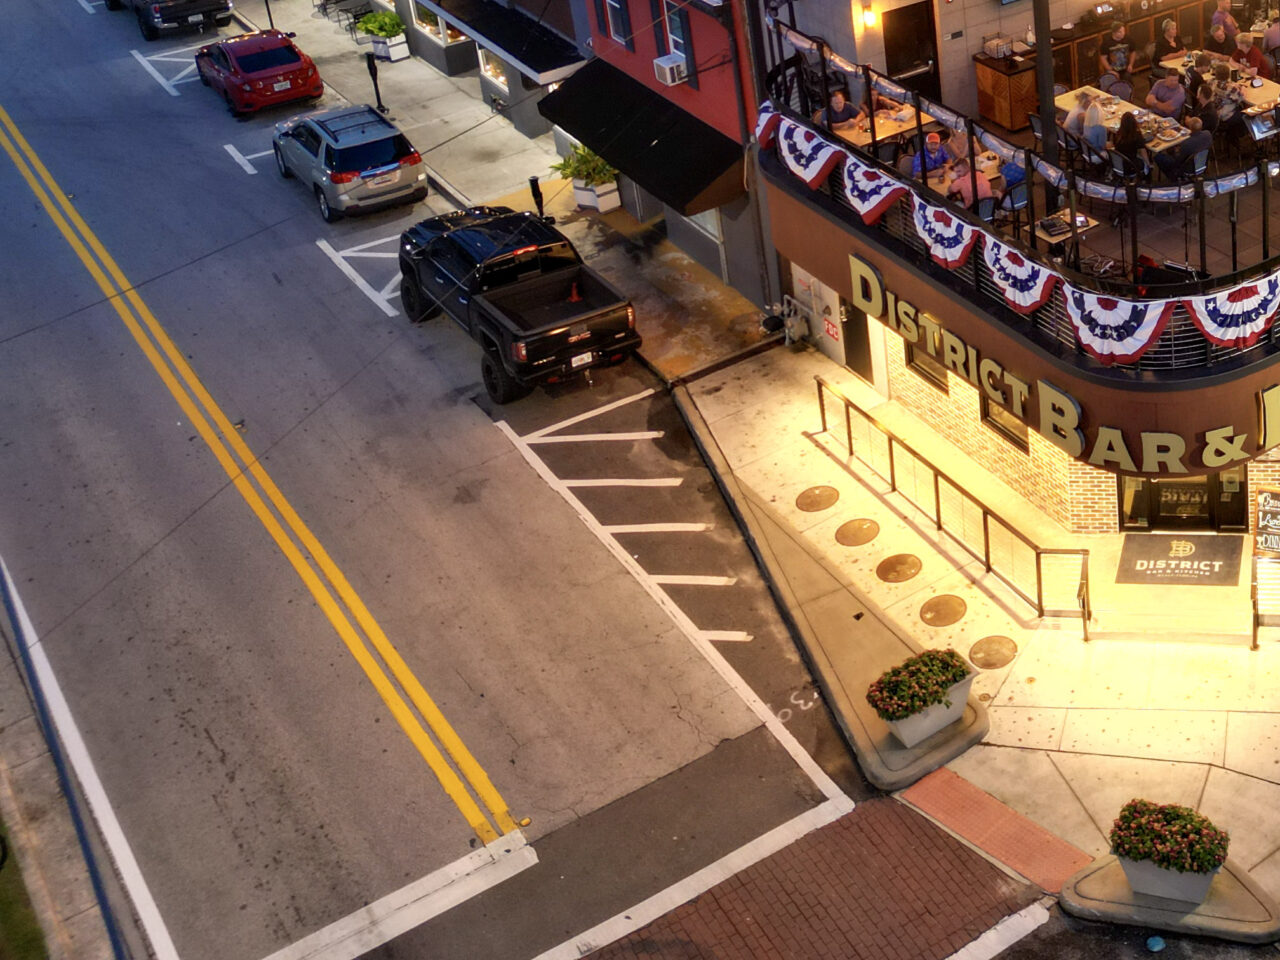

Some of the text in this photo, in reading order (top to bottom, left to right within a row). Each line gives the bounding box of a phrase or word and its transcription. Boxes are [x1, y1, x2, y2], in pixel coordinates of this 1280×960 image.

[824, 320, 839, 339] FDC
[849, 254, 1029, 418] DISTRICT
[1037, 379, 1190, 474] BAR
[1202, 425, 1251, 468] &
[1135, 559, 1223, 572] DISTRICT
